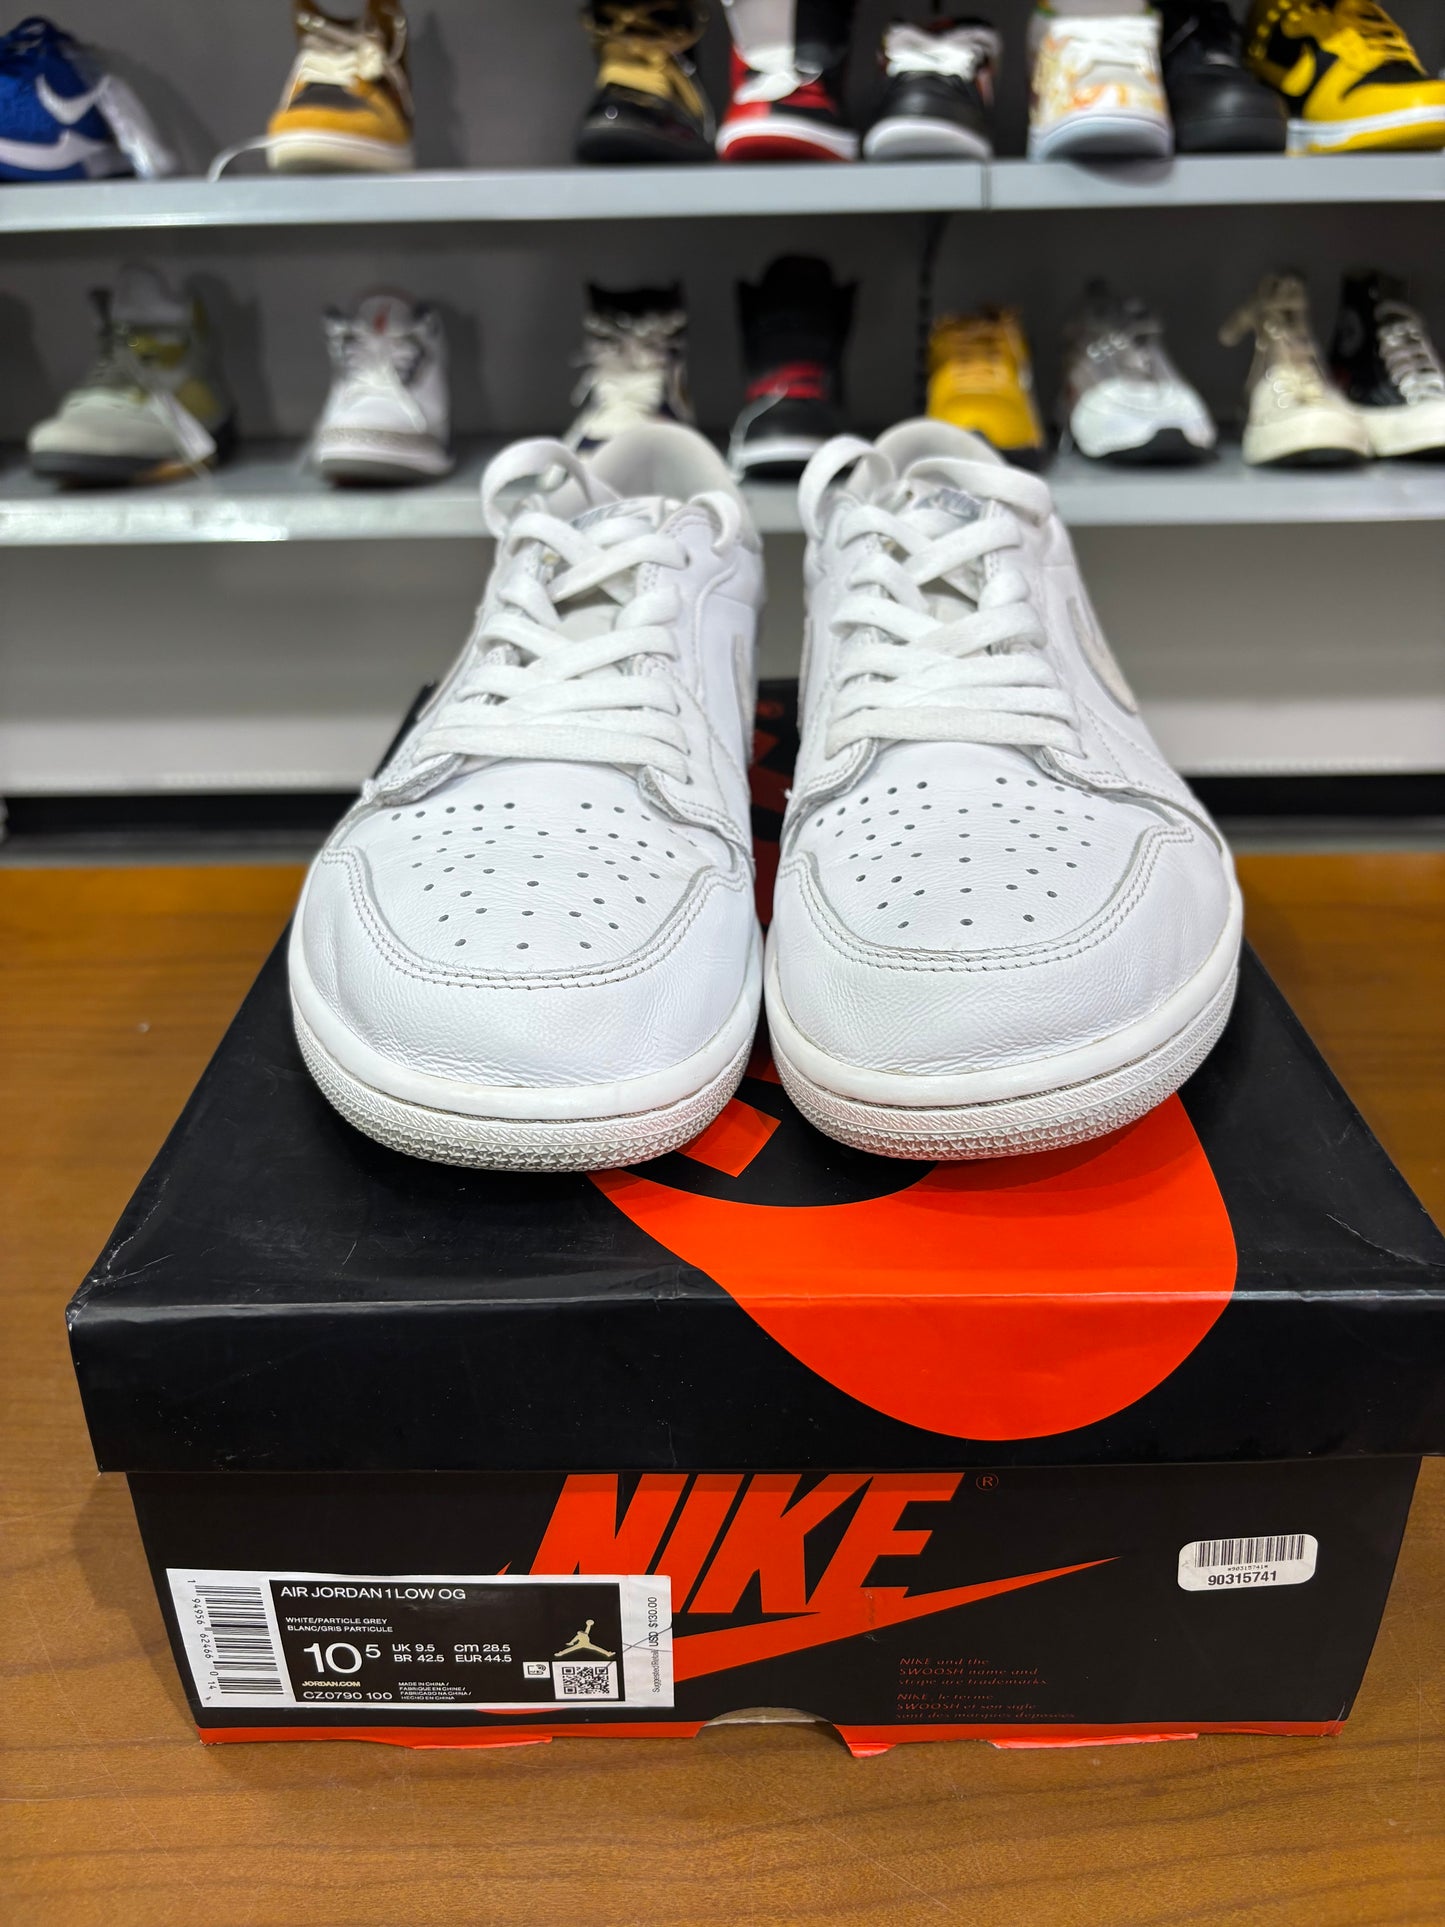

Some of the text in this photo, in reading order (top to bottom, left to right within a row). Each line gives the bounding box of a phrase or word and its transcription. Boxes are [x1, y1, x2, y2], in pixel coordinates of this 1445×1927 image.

[1208, 1570, 1277, 1586] 90315741
[280, 1586, 466, 1600] AIR JORDAN 1 LOW OG
[647, 1596, 659, 1629] $130.00
[285, 1616, 361, 1625] WHITE/PARTICLE
[192, 1598, 206, 1625] 94956
[200, 1633, 214, 1659] 62466
[648, 1631, 659, 1647] USD
[392, 1644, 436, 1653] UK 9.5
[482, 1644, 511, 1653] 28.5
[394, 1654, 445, 1662] BR 42.5
[455, 1654, 512, 1663] EUR 44.5
[303, 1691, 393, 1700] CZ0790 100
